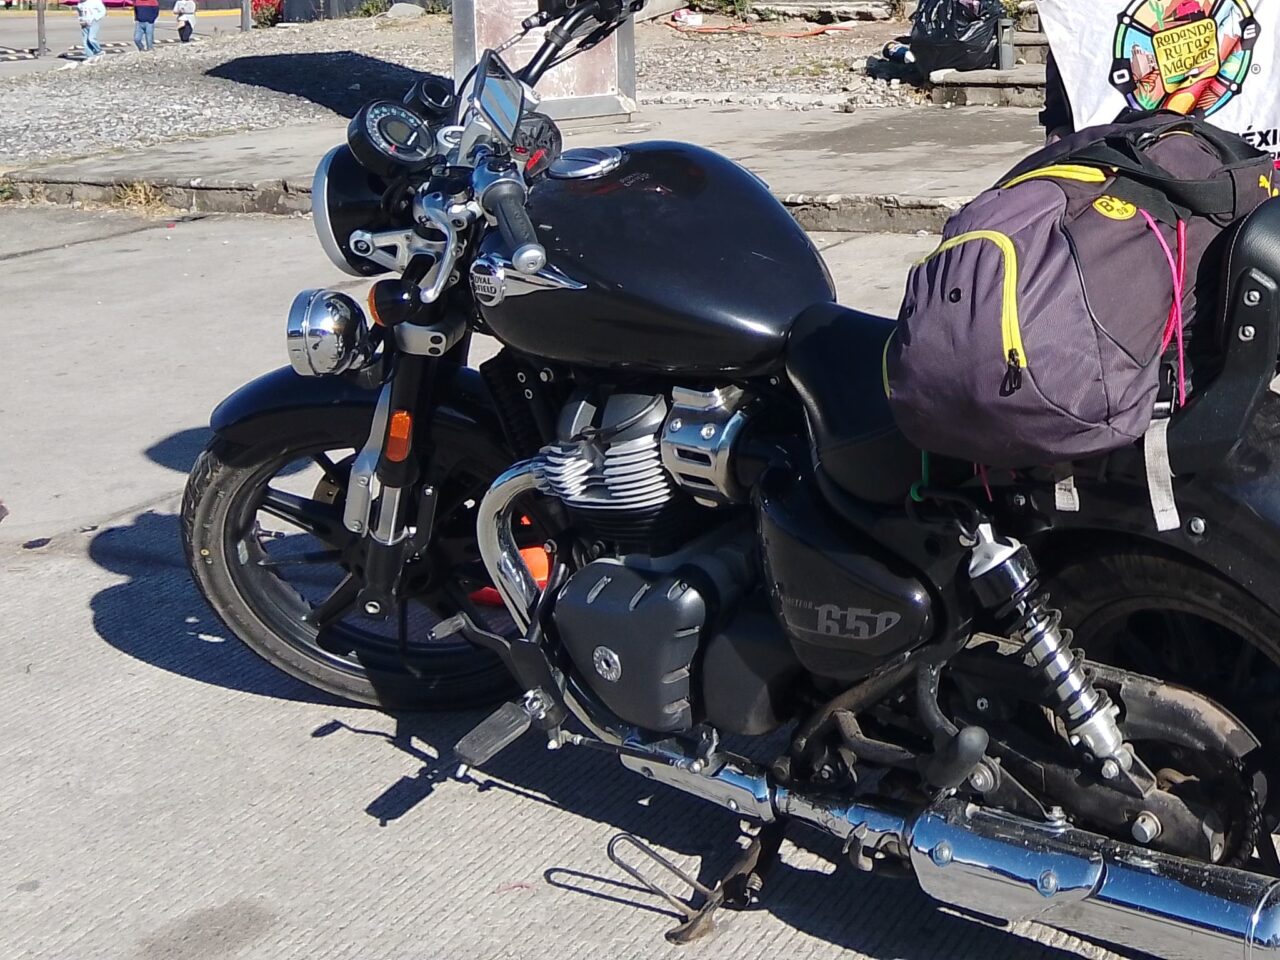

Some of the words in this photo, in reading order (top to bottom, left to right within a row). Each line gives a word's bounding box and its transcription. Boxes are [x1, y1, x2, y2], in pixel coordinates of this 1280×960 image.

[1243, 23, 1257, 40] E
[1112, 69, 1130, 84] O
[473, 276, 493, 285] OYAL
[475, 285, 497, 295] FIELD
[816, 605, 901, 639] 650
